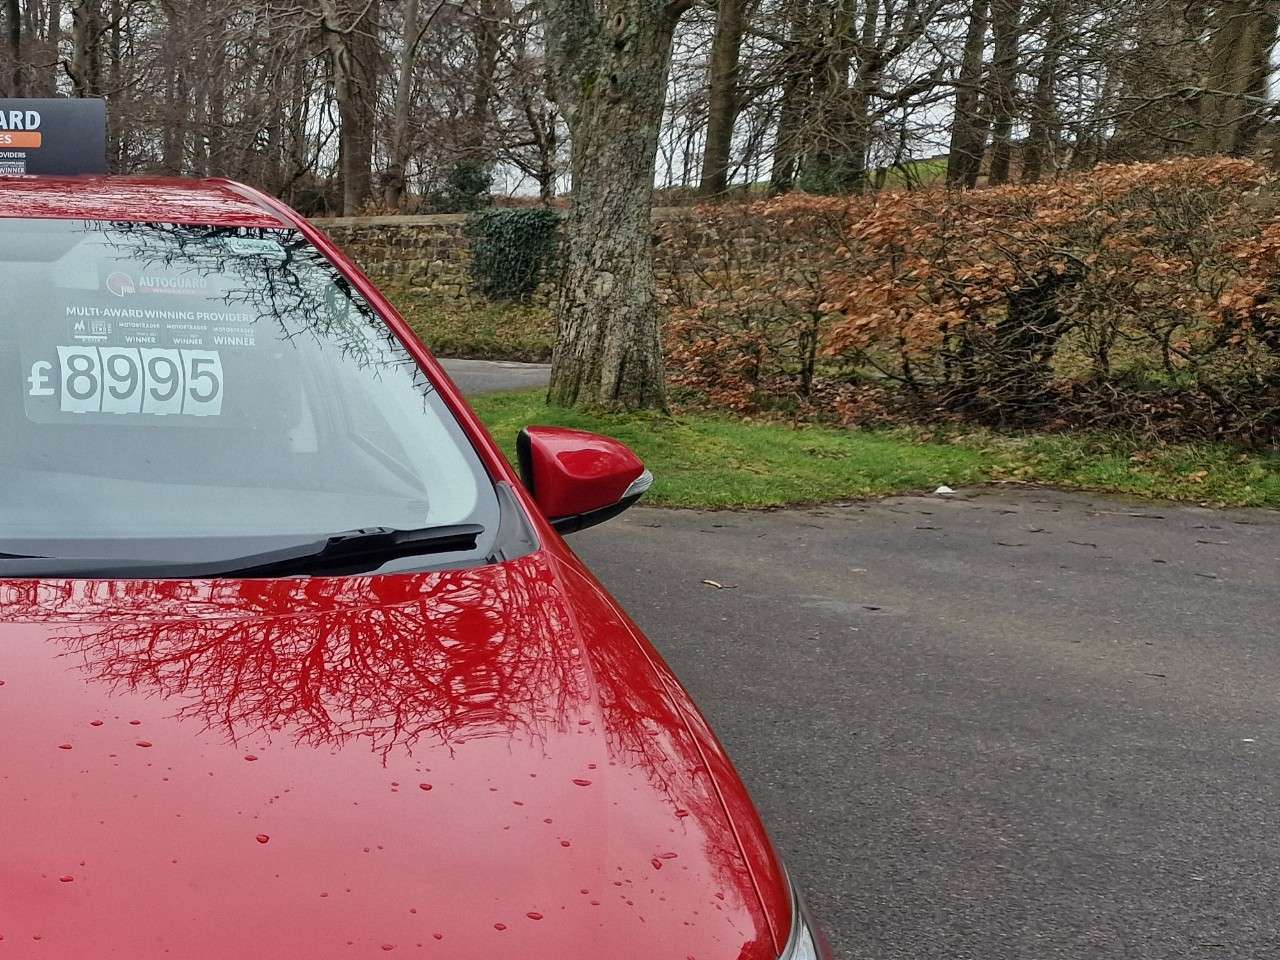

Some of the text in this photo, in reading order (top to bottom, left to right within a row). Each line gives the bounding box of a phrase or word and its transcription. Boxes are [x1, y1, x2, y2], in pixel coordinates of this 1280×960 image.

[139, 276, 207, 289] AUTOGUARD
[66, 306, 143, 318] MULTI-AWARD
[144, 309, 195, 320] WINNING
[125, 335, 157, 343] WINNER
[213, 335, 256, 346] WINNER
